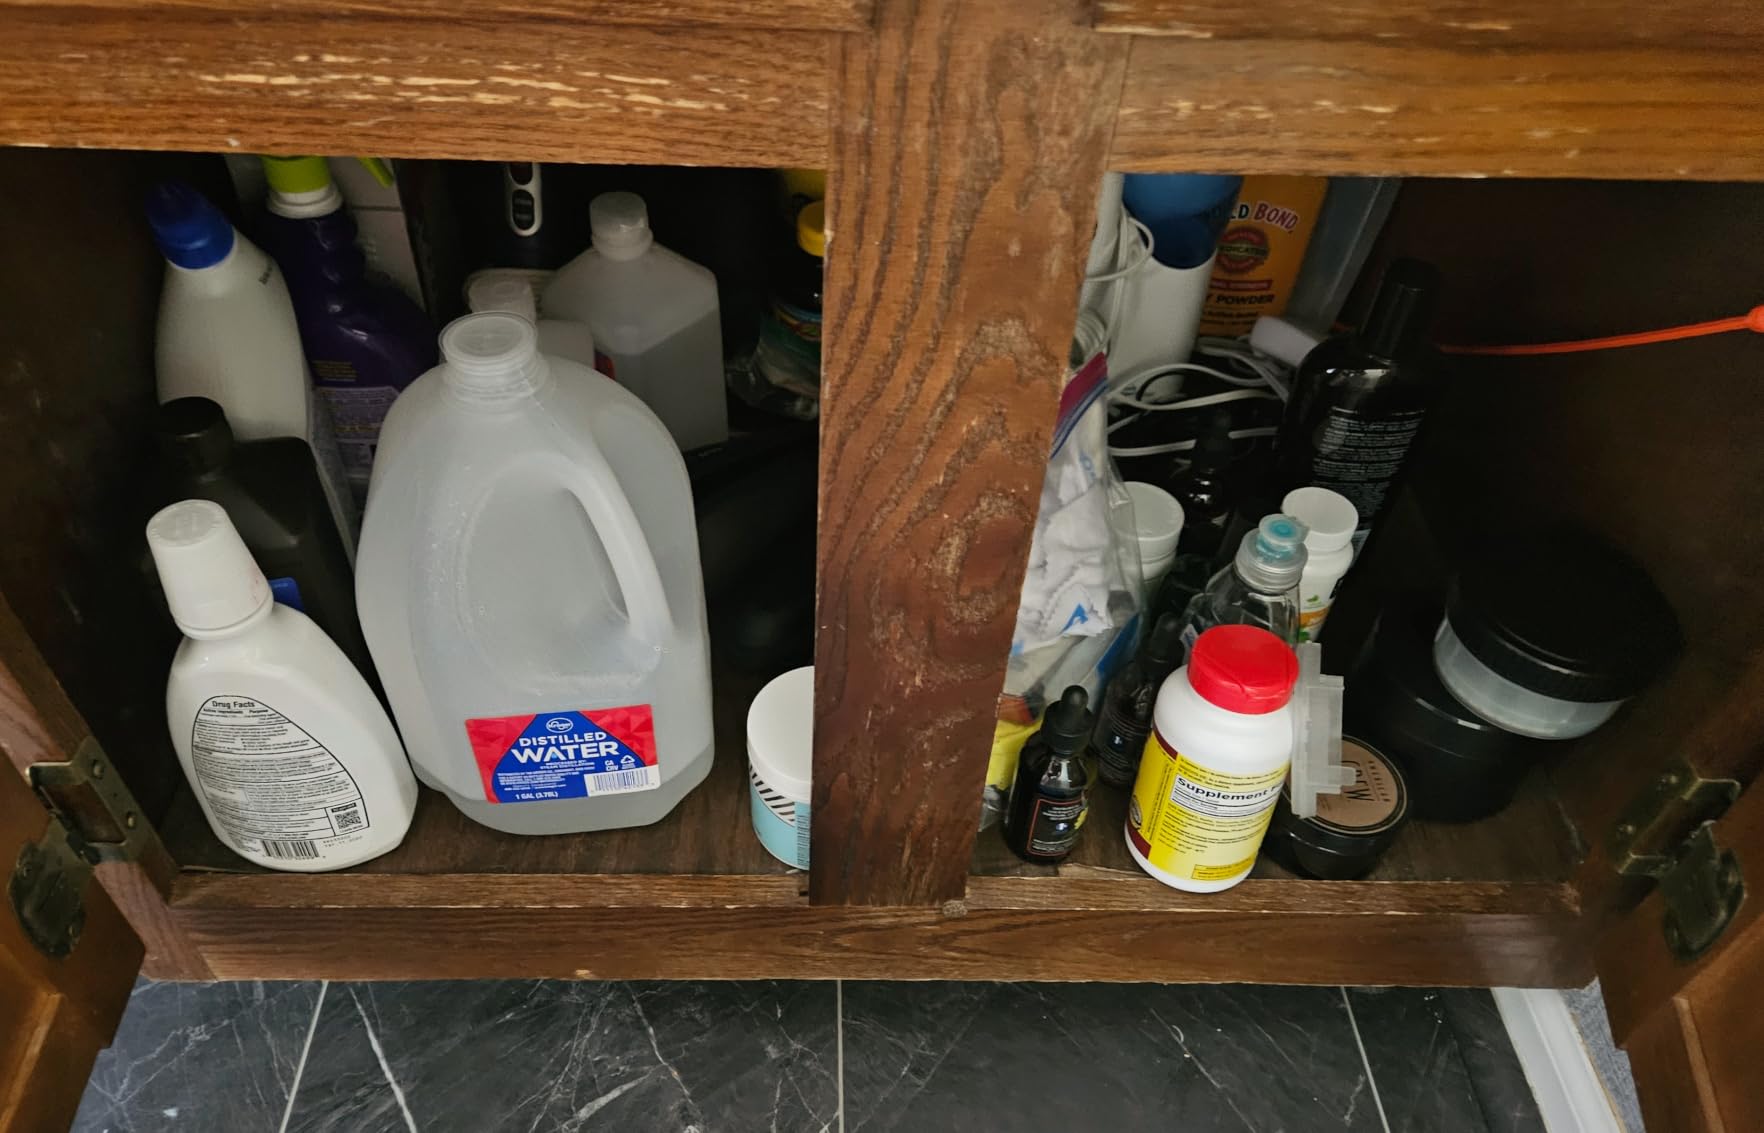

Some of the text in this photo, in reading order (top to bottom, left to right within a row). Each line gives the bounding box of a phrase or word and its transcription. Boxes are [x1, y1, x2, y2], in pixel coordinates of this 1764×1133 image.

[1254, 202, 1299, 229] BOND
[1216, 294, 1275, 305] POWDER
[212, 700, 255, 710] Drug Facts
[519, 731, 607, 747] DISTILLED
[511, 741, 620, 764] WATER
[1176, 777, 1268, 801] Supplement
